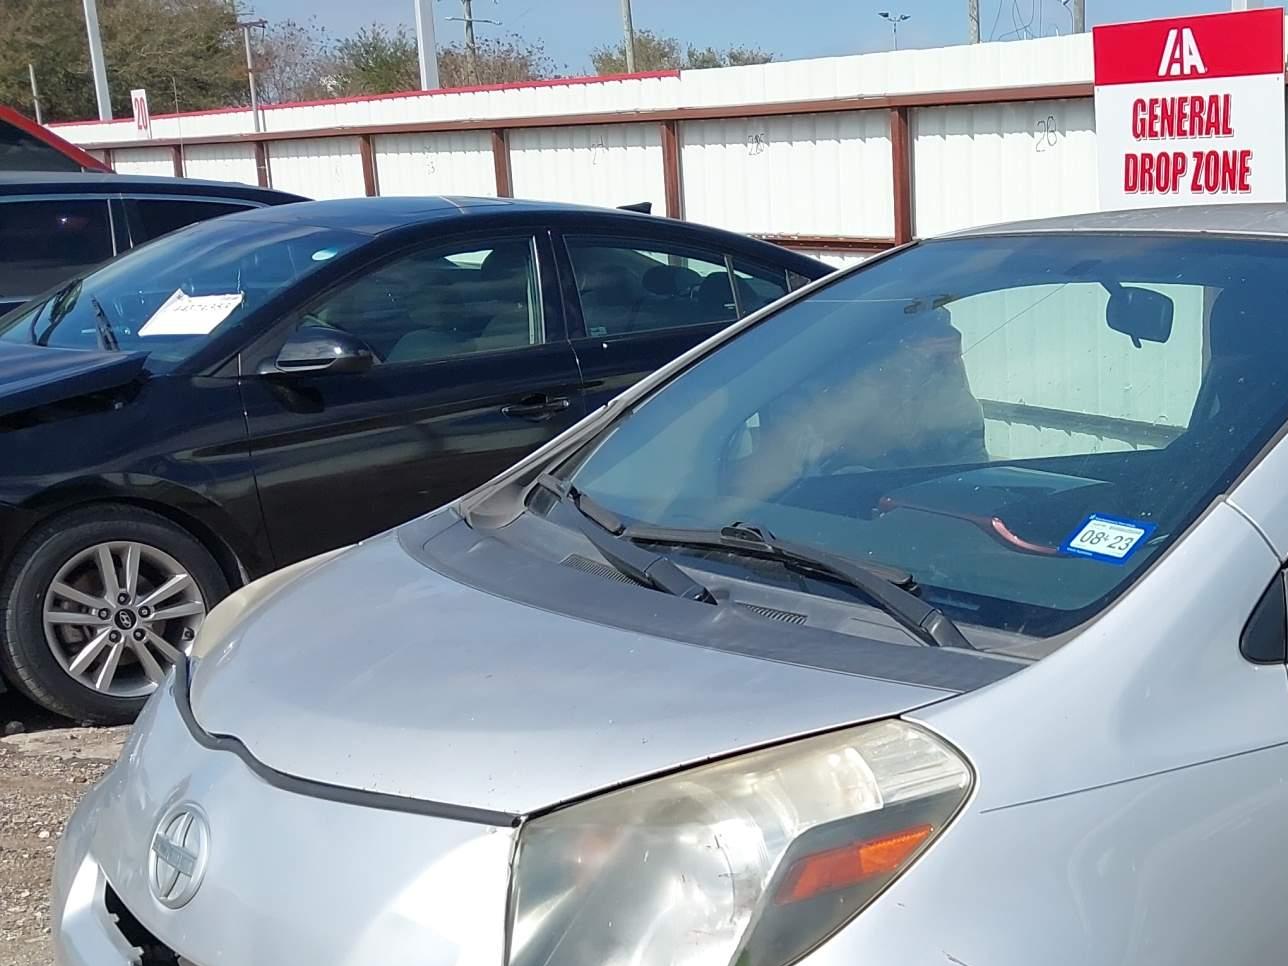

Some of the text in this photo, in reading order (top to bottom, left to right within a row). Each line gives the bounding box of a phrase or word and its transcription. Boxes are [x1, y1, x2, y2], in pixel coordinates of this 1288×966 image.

[134, 96, 148, 130] 20
[1131, 94, 1234, 141] GENERAL
[1123, 149, 1253, 195] DROP ZONE
[1079, 529, 1106, 546] 08
[1107, 535, 1134, 551] 23
